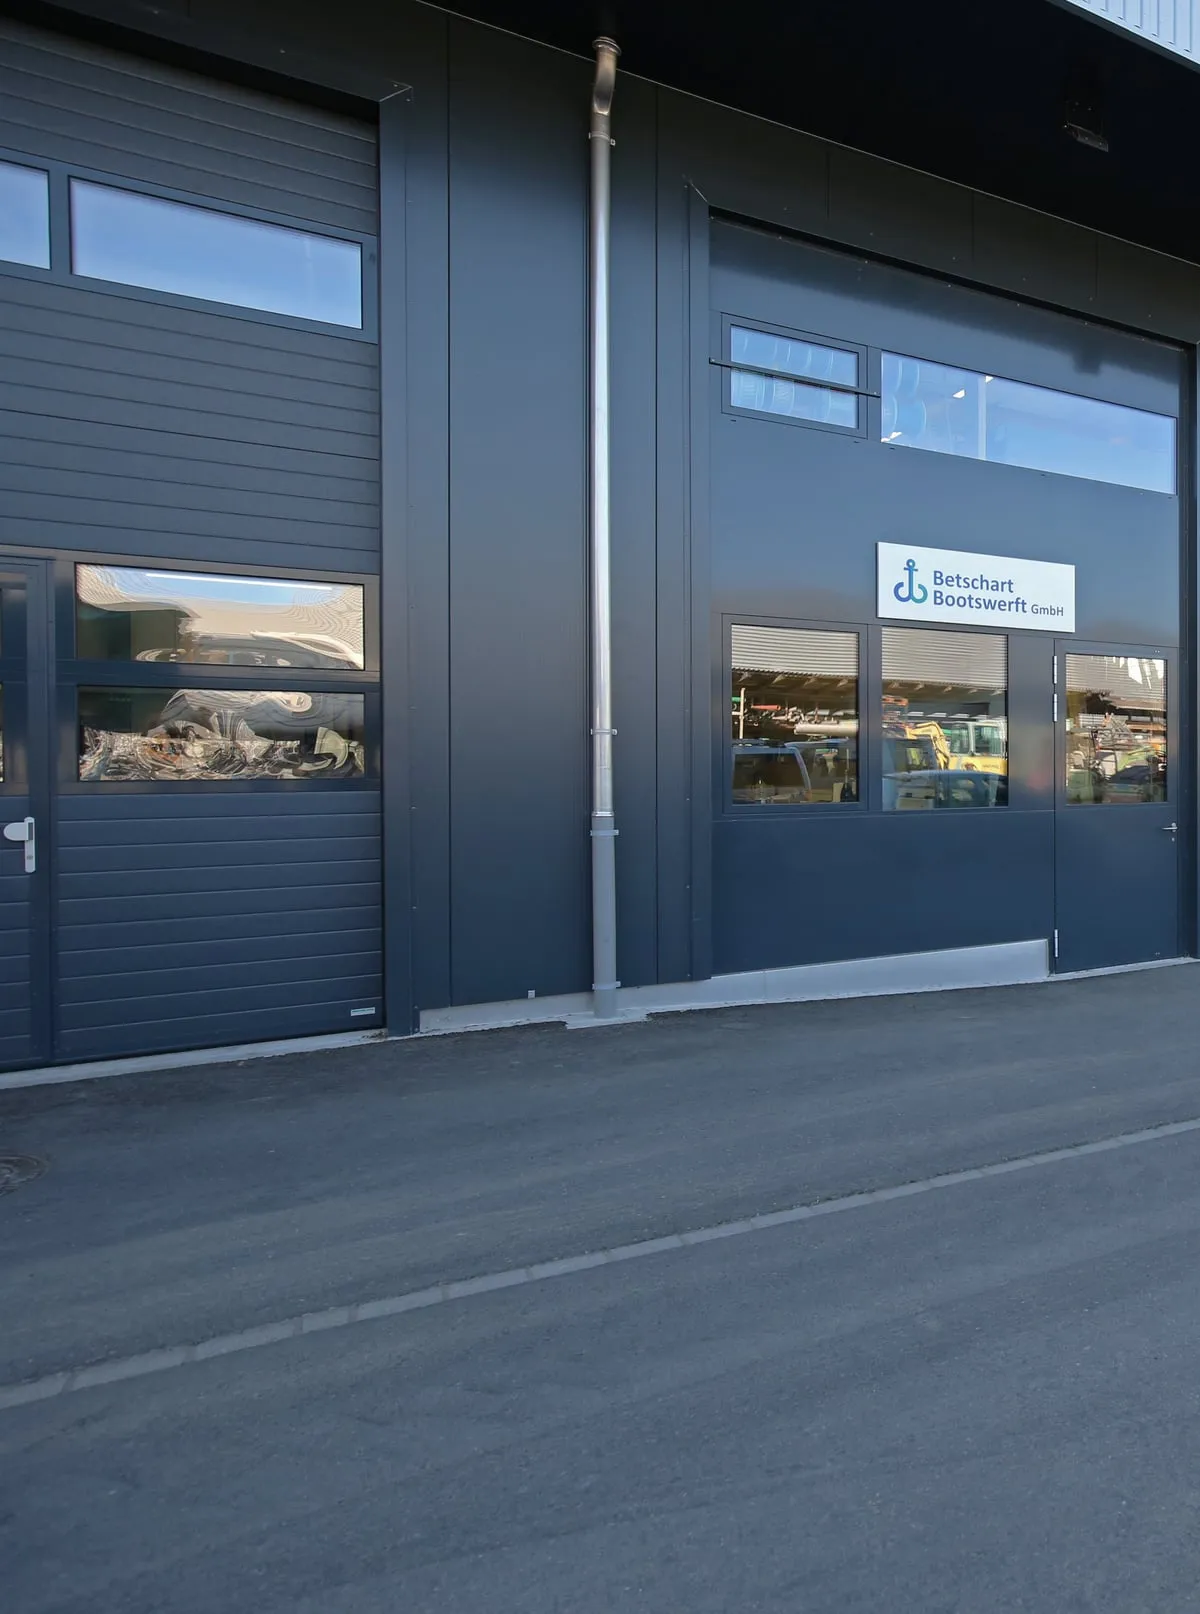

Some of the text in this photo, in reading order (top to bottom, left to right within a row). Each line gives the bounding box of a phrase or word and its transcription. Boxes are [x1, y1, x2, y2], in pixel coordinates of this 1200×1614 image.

[933, 570, 1014, 593] Betschart
[933, 590, 1064, 616] Bootswerft GmbH
